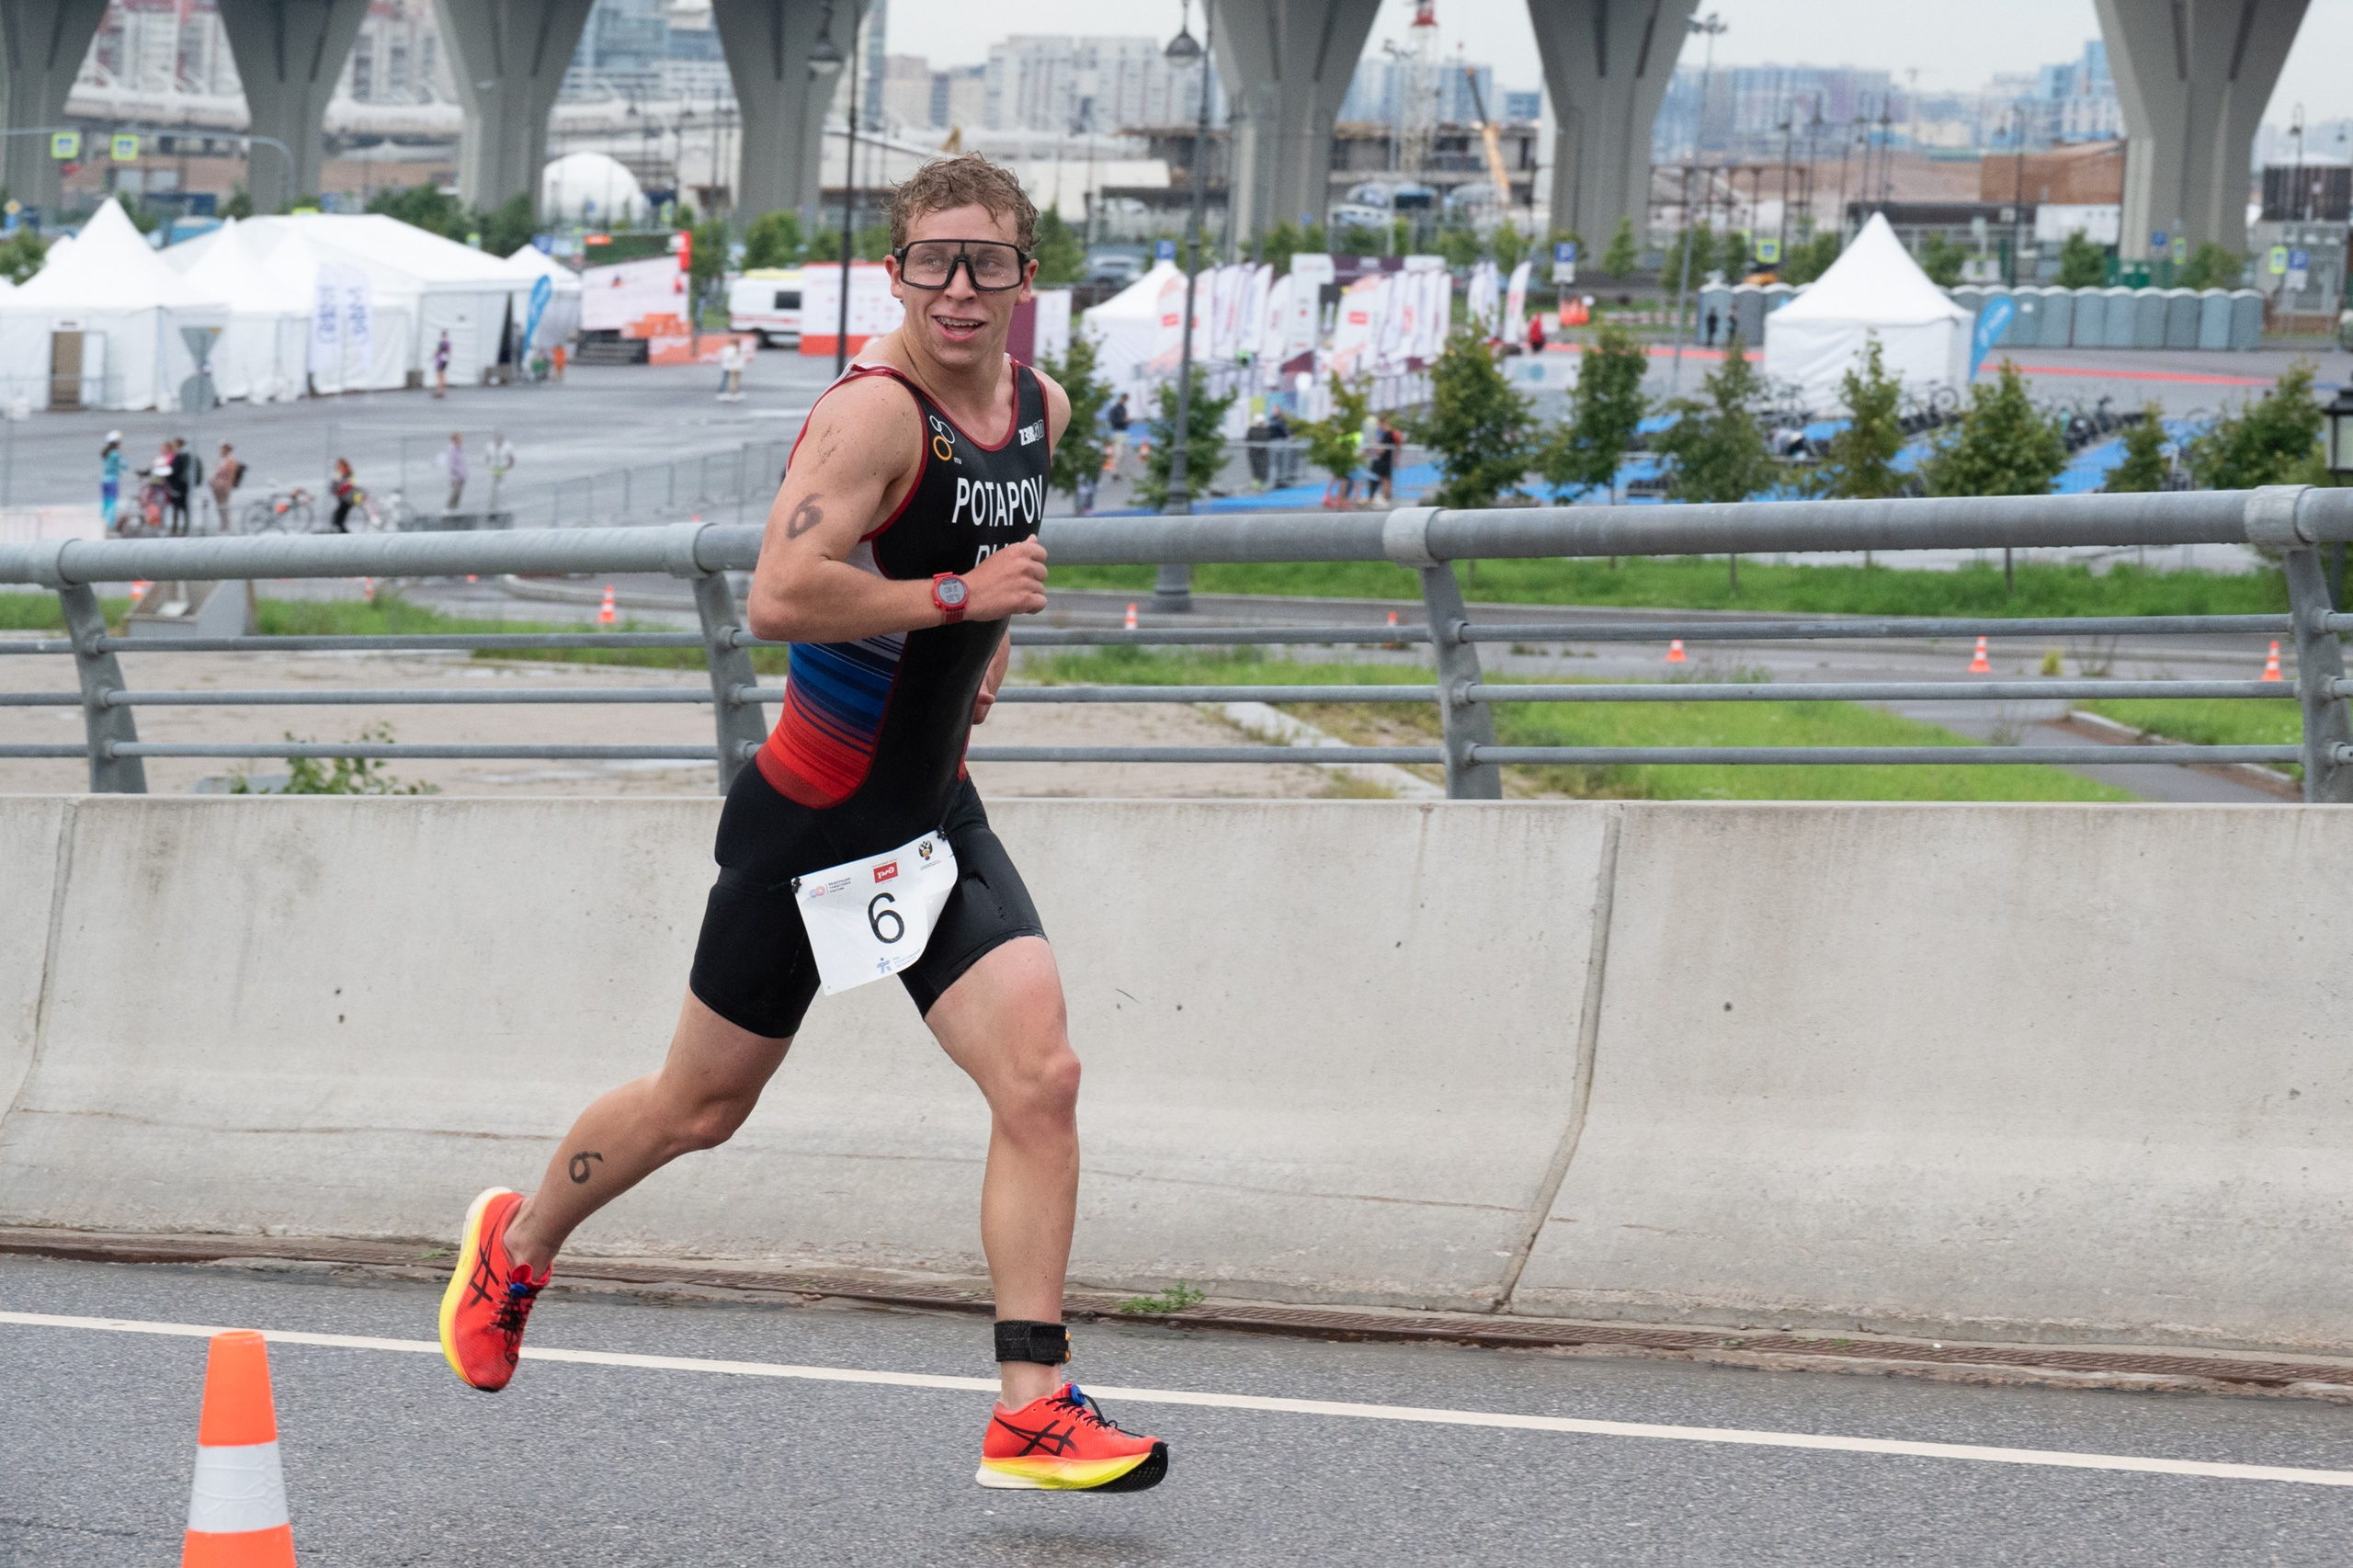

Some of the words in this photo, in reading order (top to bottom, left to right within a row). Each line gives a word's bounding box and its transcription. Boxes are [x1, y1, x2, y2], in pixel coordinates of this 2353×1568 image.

[787, 493, 824, 540] 6
[951, 474, 1042, 527] POTAPOV
[868, 892, 904, 944] 6
[568, 1151, 603, 1185] 6
